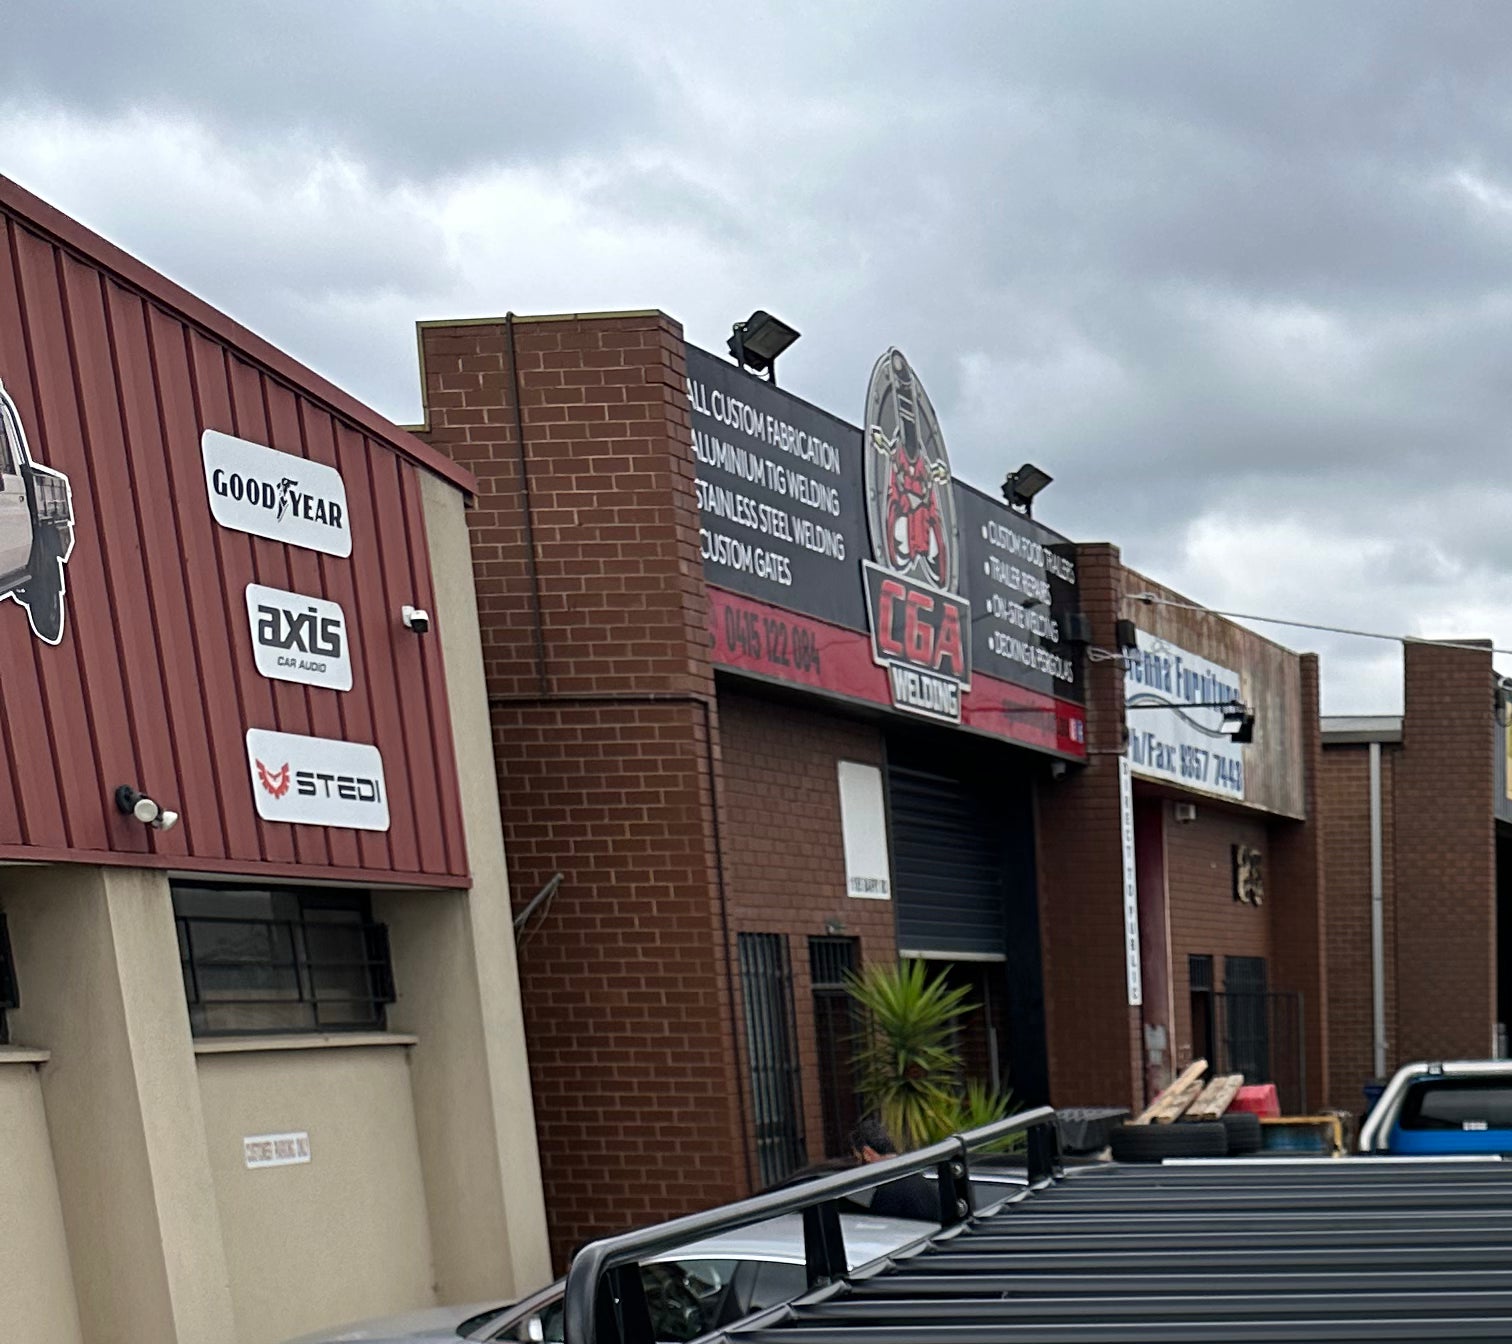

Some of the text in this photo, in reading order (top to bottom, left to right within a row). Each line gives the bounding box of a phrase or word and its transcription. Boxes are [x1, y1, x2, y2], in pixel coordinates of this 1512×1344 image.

[711, 390, 765, 442] CUSTOM
[765, 415, 841, 476] FABRICATION
[690, 428, 841, 517] ALUMINIUM TIG WELDING
[694, 478, 846, 561] STAINLESS STEEL WELDING
[699, 528, 793, 586] CUSTOM GATES
[257, 604, 341, 659] axis
[762, 617, 791, 667] 122
[277, 656, 327, 673] CAR AUDIO
[891, 665, 959, 716] WELDING
[296, 770, 382, 804] STEDI
